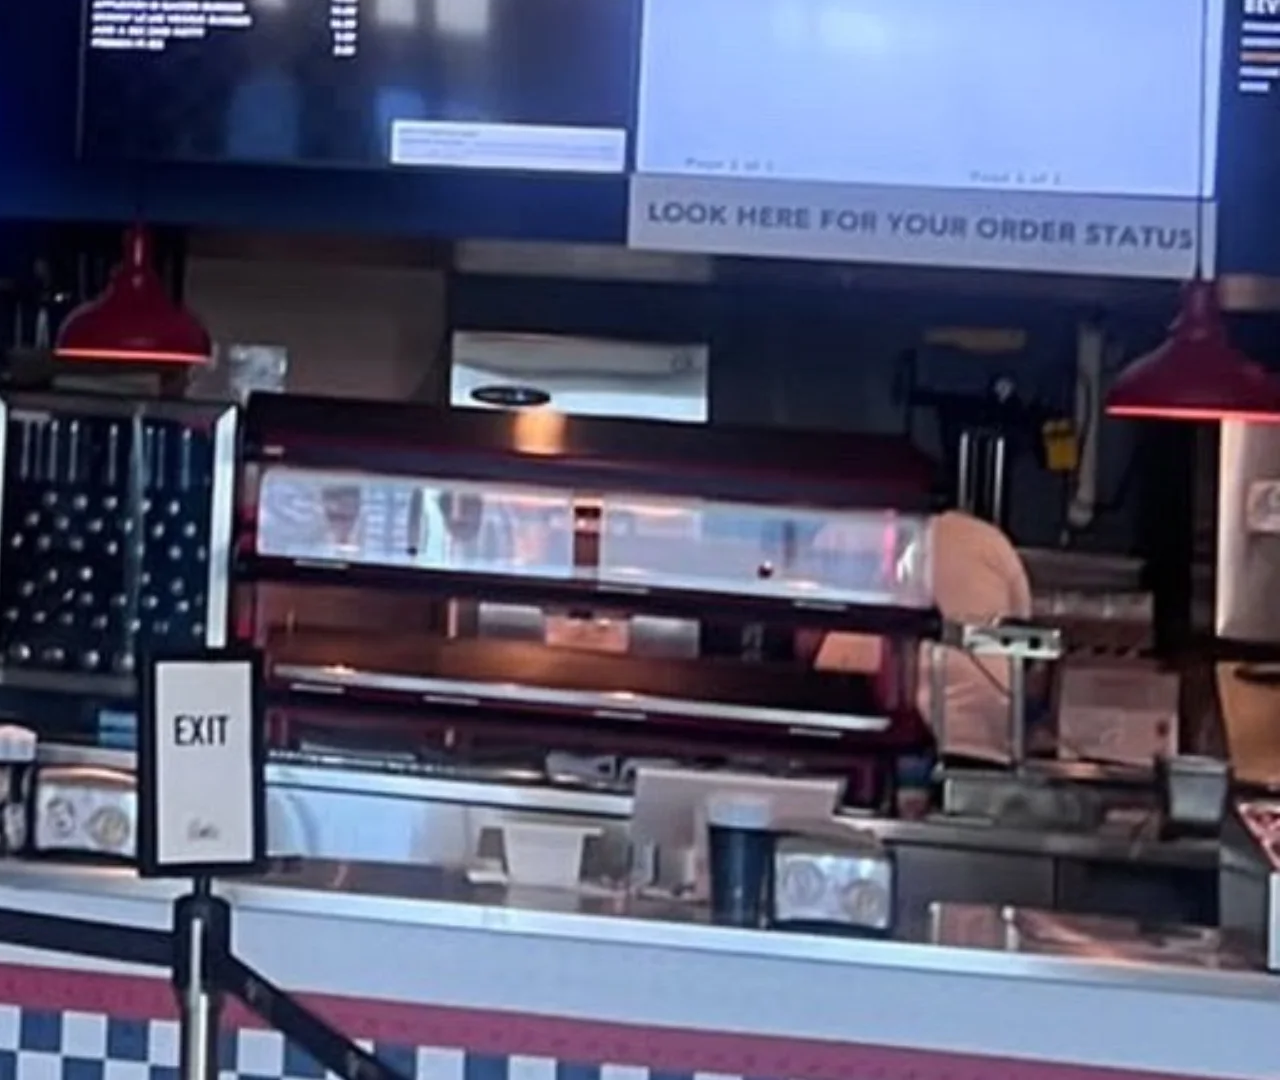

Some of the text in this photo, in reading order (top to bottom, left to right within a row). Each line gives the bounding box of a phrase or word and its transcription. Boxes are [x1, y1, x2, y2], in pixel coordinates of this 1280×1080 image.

[648, 202, 1194, 251] LOOK HERE FOR YOUR ORDER STATUS
[173, 715, 228, 747] EXIT
